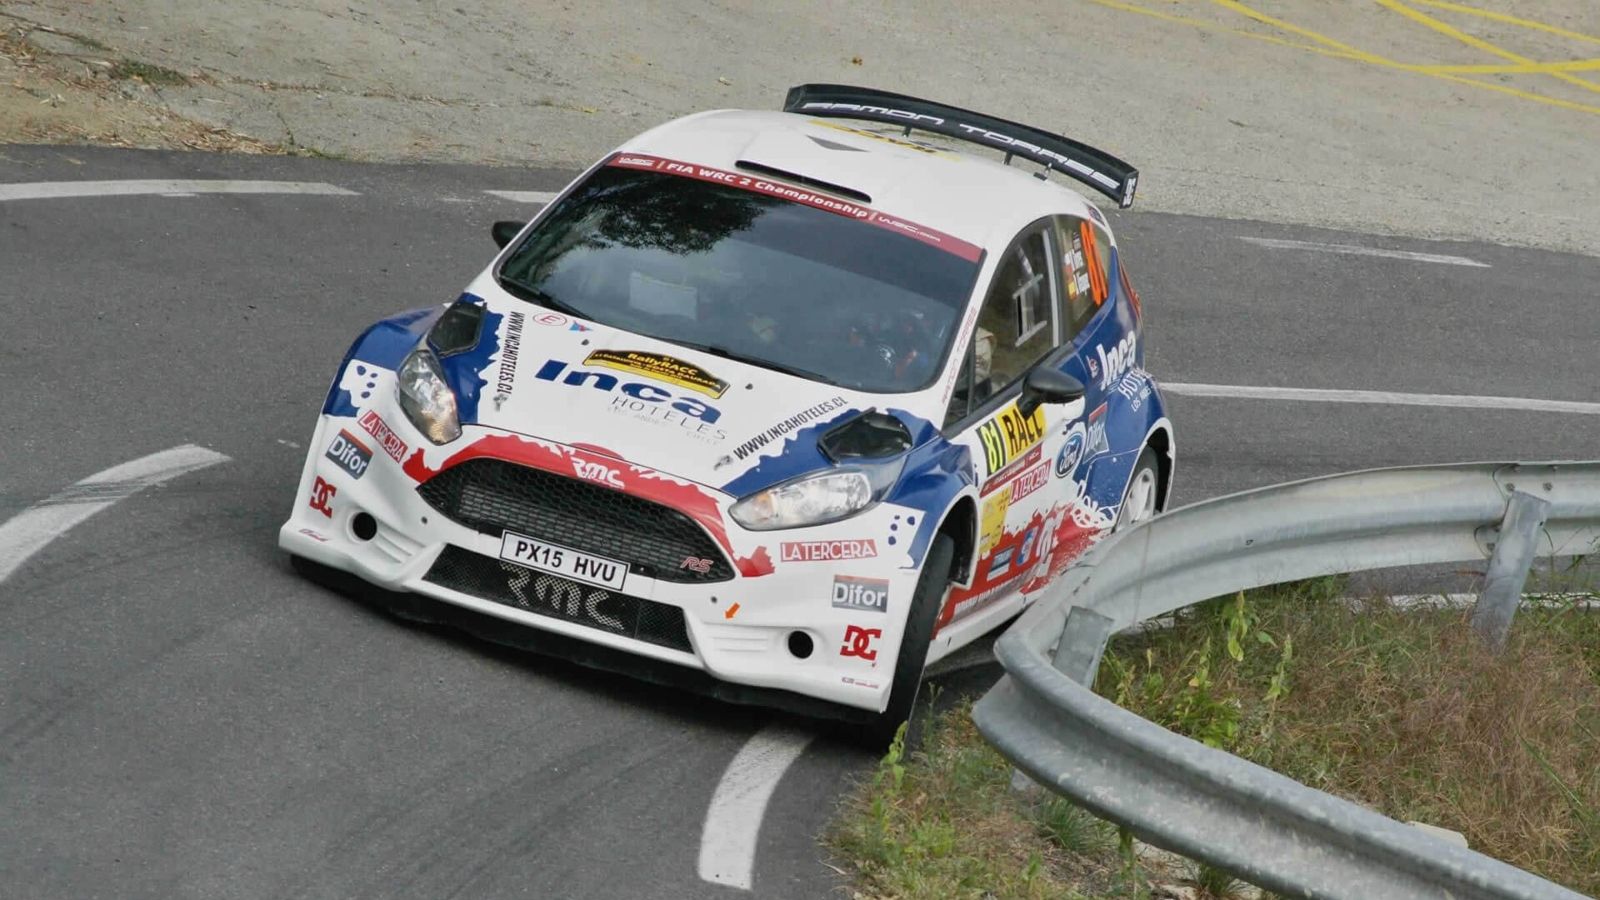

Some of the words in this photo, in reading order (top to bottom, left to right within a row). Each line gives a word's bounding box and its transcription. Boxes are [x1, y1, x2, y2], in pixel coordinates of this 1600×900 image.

[959, 123, 1120, 189] TORRES
[667, 162, 694, 175] FIA
[699, 168, 736, 183] WRC
[739, 177, 751, 187] 2
[754, 181, 868, 219] Championship
[627, 353, 698, 376] RallyRACC
[1096, 330, 1136, 391] Inca
[535, 359, 721, 424] Inca
[611, 396, 728, 440] HOTELES
[733, 396, 848, 461] WWW.INCAHOTELES.CL
[328, 434, 367, 474] Difor
[980, 420, 1003, 474] 81
[515, 540, 563, 568] PX15
[574, 556, 616, 582] HVU
[680, 556, 714, 573] RS
[833, 582, 887, 607] Difor
[840, 625, 882, 661] DC
